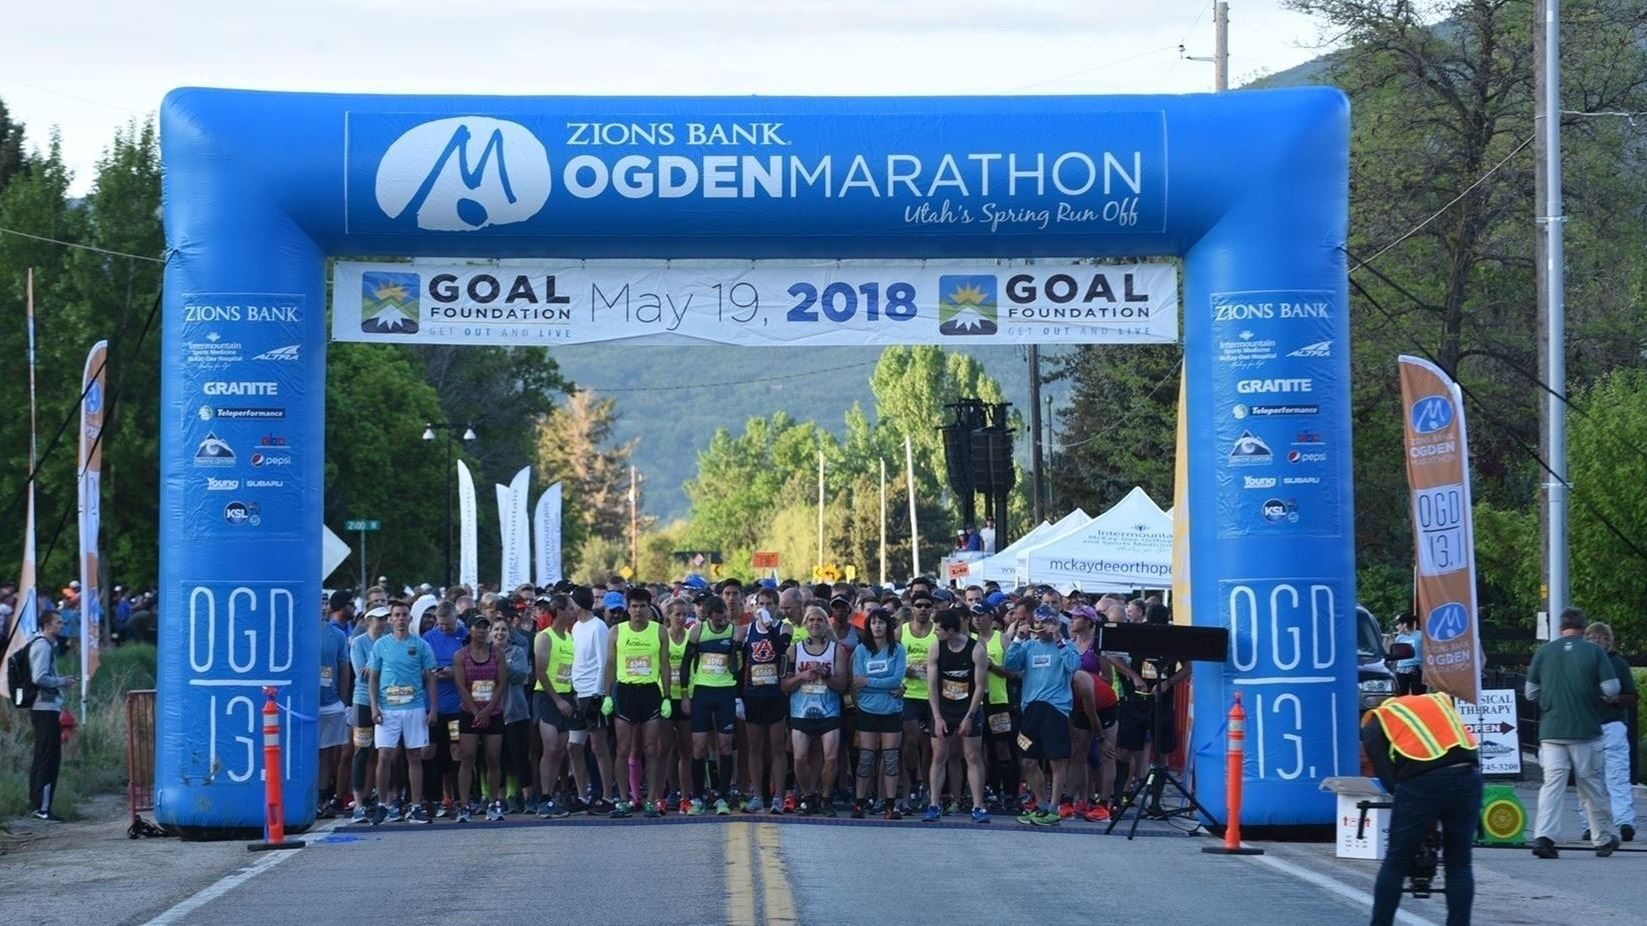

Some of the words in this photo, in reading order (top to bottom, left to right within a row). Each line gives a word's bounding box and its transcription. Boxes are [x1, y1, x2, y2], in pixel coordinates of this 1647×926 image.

[566, 122, 676, 145] ZIONS
[686, 122, 788, 145] BANK
[904, 200, 974, 224] Utah's
[980, 203, 1050, 233] Spring
[1056, 201, 1098, 222] Run
[1102, 197, 1139, 227] Off
[429, 274, 570, 305] GOAL
[1005, 274, 1149, 304] GOAL
[590, 282, 694, 331] May
[711, 282, 768, 326] 19,
[786, 281, 918, 323] 2018
[1008, 306, 1149, 319] FOUNDATION
[1215, 303, 1273, 321] ZIONS
[1280, 303, 1329, 318] BANK
[184, 306, 240, 321] ZIONS
[247, 306, 299, 321] BANK
[430, 307, 571, 320] FOUNDATION
[429, 328, 455, 337] GET
[464, 328, 491, 337] OUT
[501, 328, 529, 337] AND
[539, 329, 571, 338] LIVE
[1008, 327, 1033, 336] GET
[1043, 327, 1070, 336] OUT
[1080, 327, 1108, 336] AND
[1118, 327, 1152, 336] LIVE
[203, 382, 278, 395] GRANITE
[1237, 379, 1312, 393] GRANITE
[217, 408, 284, 418] Teleperformance
[1251, 405, 1318, 415] Teleperformance
[1410, 441, 1456, 458] OGDEN
[266, 456, 291, 466] pepsi
[1302, 453, 1327, 462] pepsi
[207, 477, 240, 488] Young
[1244, 475, 1277, 487] Young
[227, 509, 248, 519] KSL
[1264, 506, 1286, 516] KSL
[1419, 490, 1460, 528] OGD
[1430, 531, 1461, 568] 13.1
[189, 586, 294, 673] OGD
[1230, 584, 1335, 672] OGD
[1427, 650, 1470, 665] OGDEN
[1458, 695, 1513, 705] SICAL
[1460, 705, 1513, 715] THERAPY
[1256, 692, 1339, 780] 13.1
